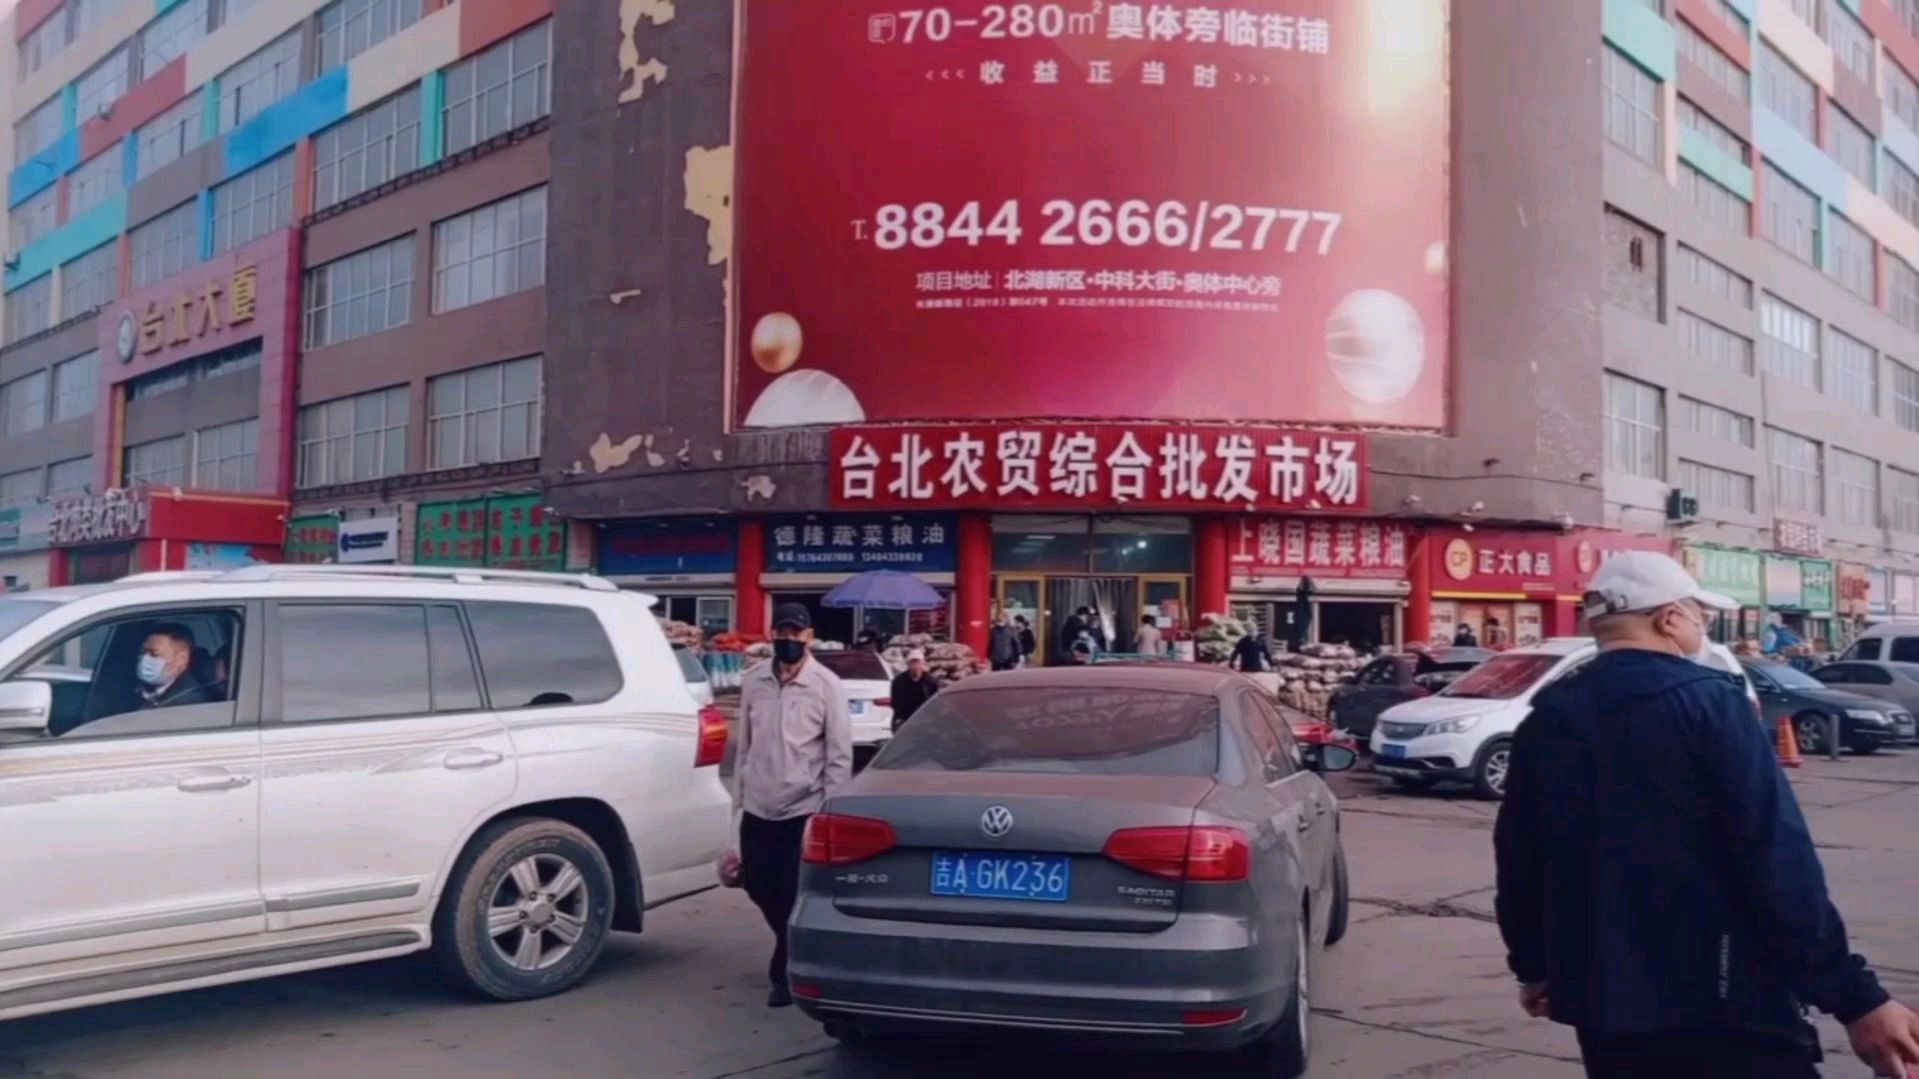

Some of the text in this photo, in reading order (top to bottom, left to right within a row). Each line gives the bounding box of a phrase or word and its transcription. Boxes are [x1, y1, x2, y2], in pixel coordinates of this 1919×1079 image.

[979, 60, 1218, 88] 收益正当时
[874, 199, 1022, 250] 8844
[1040, 199, 1342, 255] 2666/2777
[916, 271, 992, 291] 项目地址
[840, 431, 1358, 504] 台北农贸综合批发市场
[774, 524, 945, 547] 德隆蔬菜粮油
[1479, 549, 1551, 576] 正大食品
